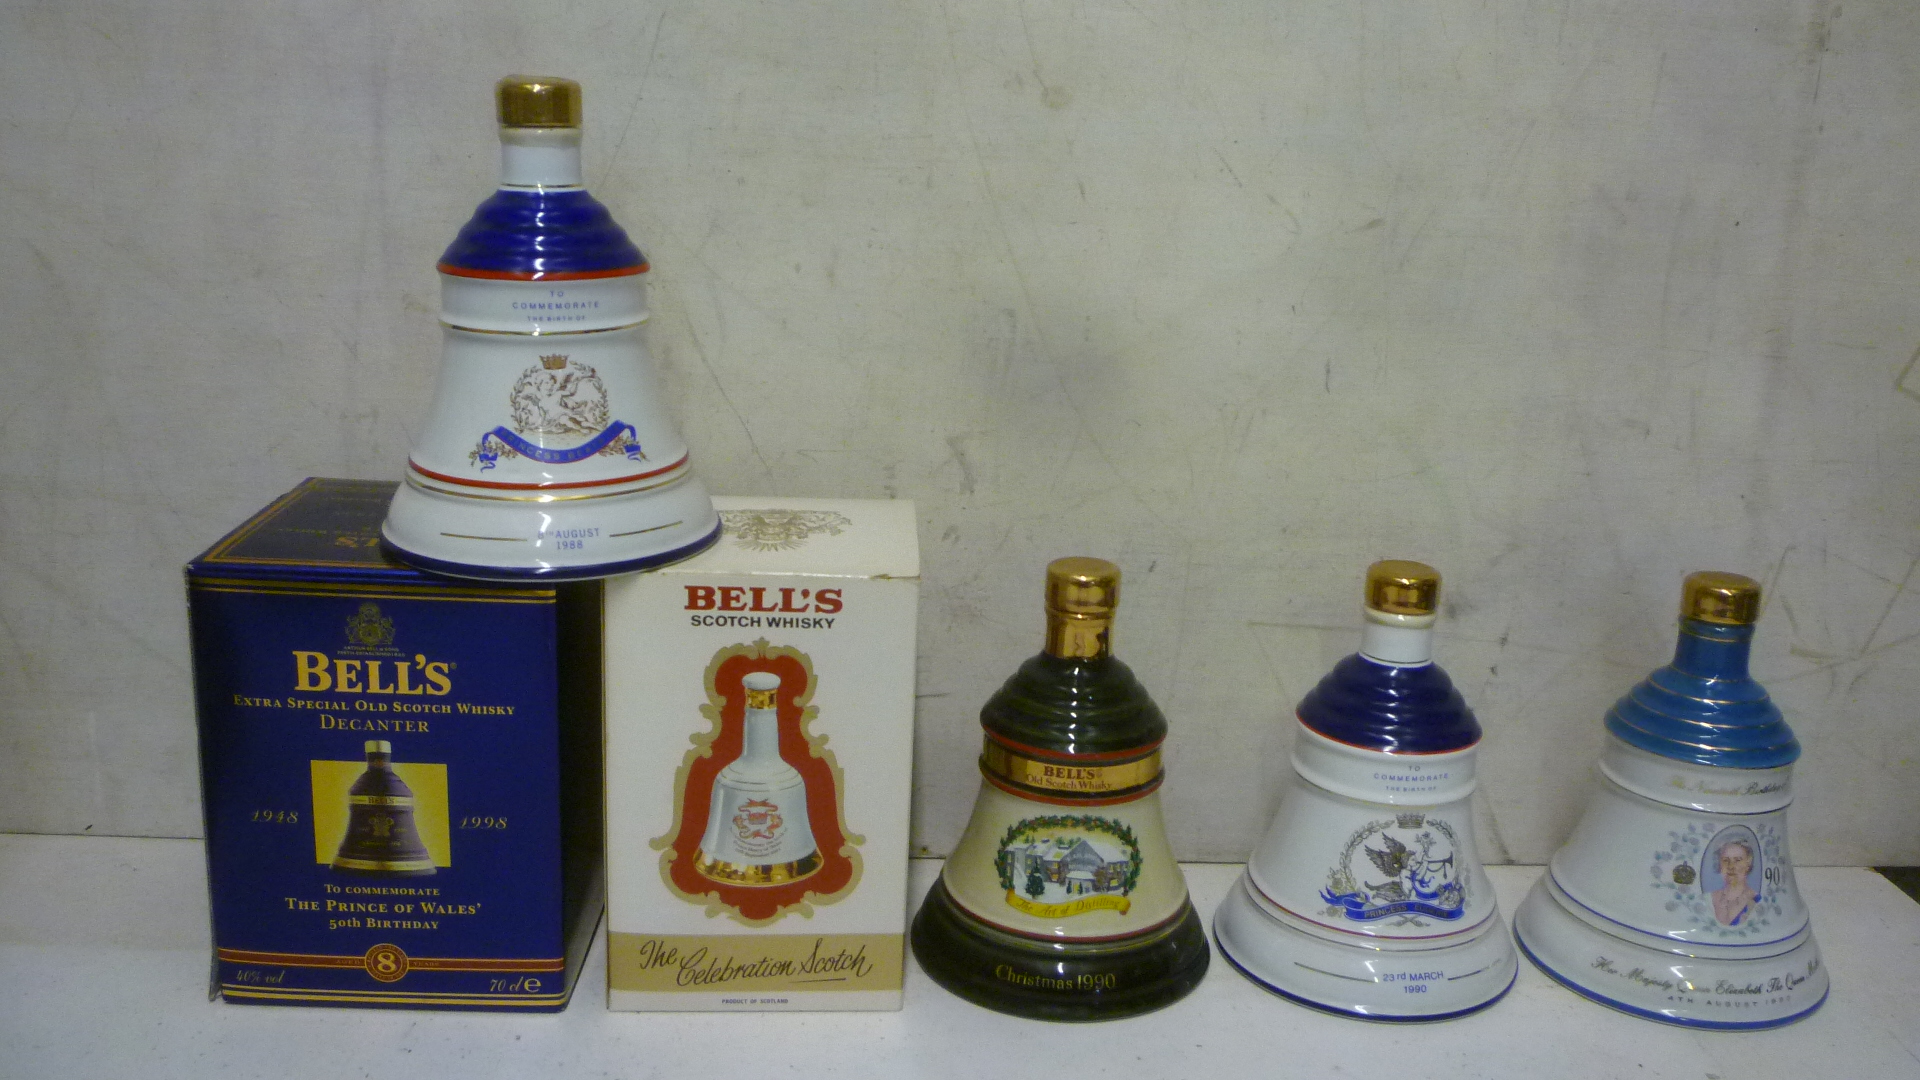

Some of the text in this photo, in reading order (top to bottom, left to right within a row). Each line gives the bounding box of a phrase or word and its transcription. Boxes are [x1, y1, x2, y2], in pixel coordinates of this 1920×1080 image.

[512, 302, 600, 310] COMMEMORATE
[555, 527, 600, 540] AUGUST
[556, 539, 584, 550] 1988
[684, 585, 844, 614] BELL'S
[691, 615, 836, 629] SCOTCH WHISKY
[292, 650, 452, 697] BELL'S
[287, 697, 350, 711] SPECIAL
[354, 700, 388, 712] OLD
[393, 701, 451, 714] SCOTCH
[456, 703, 516, 716] WHISKY
[320, 714, 430, 733] DECANTER
[1044, 765, 1095, 780] BELL'S
[1374, 773, 1449, 782] COMMEMORATE
[1027, 773, 1043, 785] Old
[1045, 777, 1077, 791] Scotch
[251, 809, 299, 825] 1948
[459, 816, 508, 831] 1998
[1764, 865, 1780, 887] 90
[285, 897, 320, 911] THE
[326, 900, 388, 914] PRINCE
[1364, 904, 1408, 918] PRINCESS
[329, 917, 439, 930] 50th BIRTHDAY
[377, 952, 398, 973] 8
[640, 937, 872, 986] The Celebration Scotch
[996, 964, 1116, 991] Christmas 1990
[1409, 970, 1444, 982] MARCH
[1591, 956, 1618, 974] Her
[1766, 976, 1784, 993] The
[490, 978, 506, 992] 70
[1404, 984, 1428, 994] 1990
